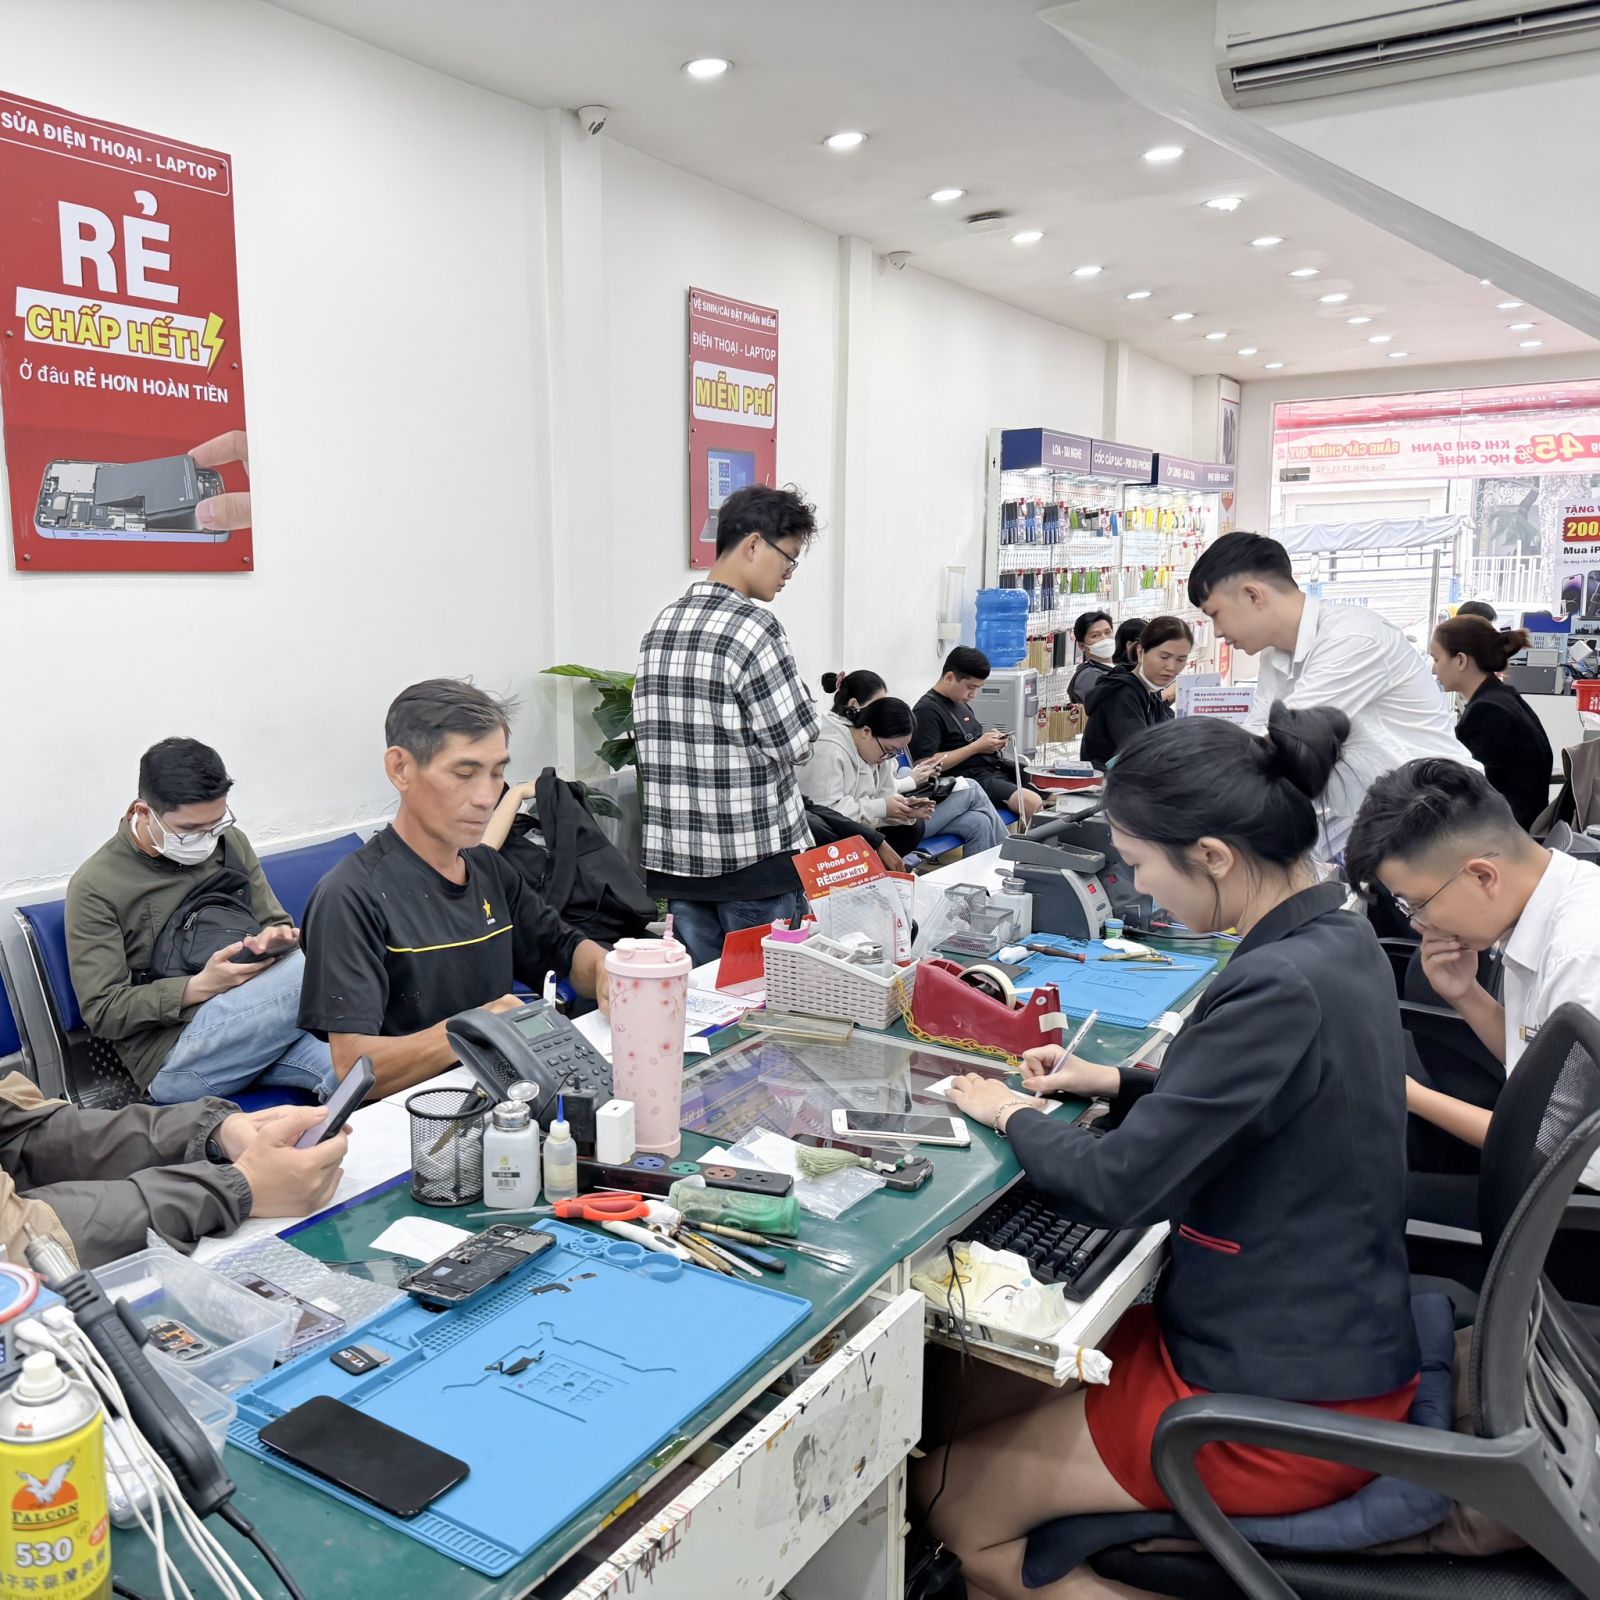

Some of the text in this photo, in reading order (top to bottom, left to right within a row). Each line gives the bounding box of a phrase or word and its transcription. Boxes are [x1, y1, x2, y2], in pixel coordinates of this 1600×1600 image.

[1, 111, 40, 136] SỬA
[43, 123, 87, 149] ĐIỆN
[90, 136, 142, 165] THOẠI
[155, 153, 218, 181] LAPTOP
[58, 190, 180, 304] RẺ
[26, 304, 200, 361] CHẤP HẾT!
[693, 331, 713, 350] ĐIỆN
[713, 336, 738, 356] THOẠI
[745, 344, 776, 361] LAPTOP
[19, 358, 229, 404] Ở đâu RẺ HƠN HOÀN TIỀN
[695, 371, 774, 416] MIỄN PHÍ
[1565, 505, 1595, 515] TẶNG
[816, 852, 859, 871] iPhone Cũ
[816, 872, 831, 887] RẺ
[12, 1504, 78, 1522] FALCON
[16, 1536, 74, 1568] 530
